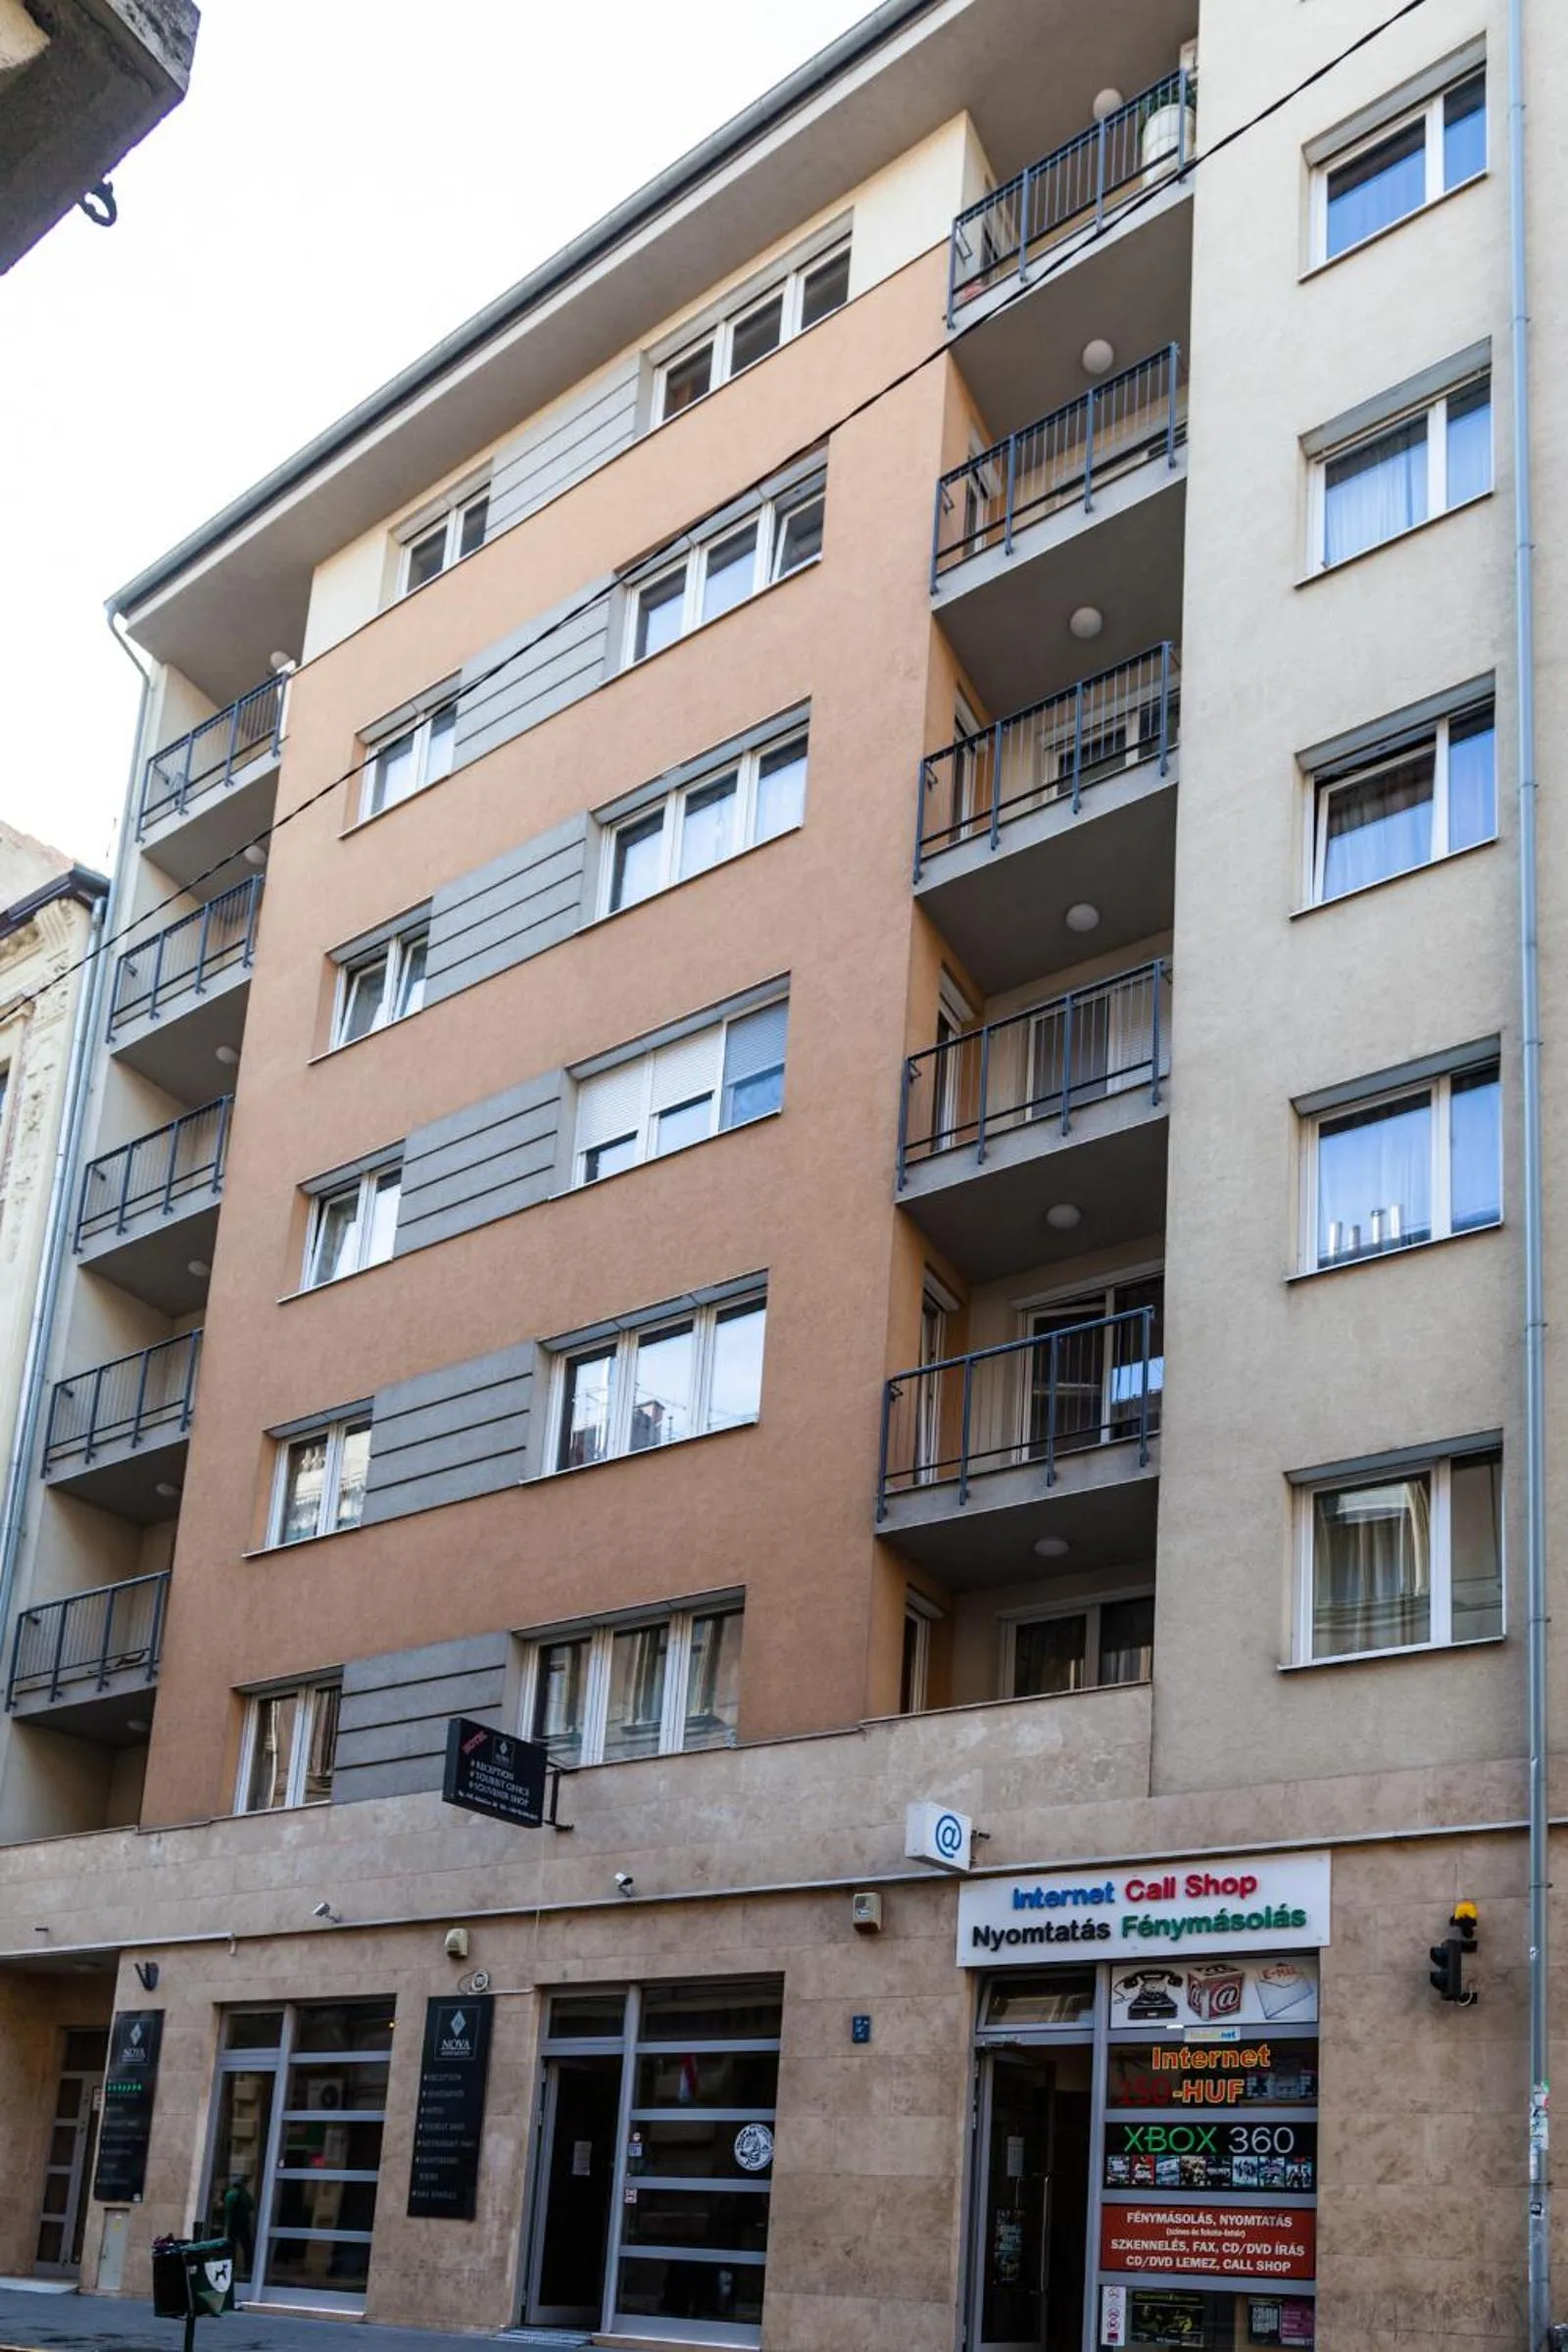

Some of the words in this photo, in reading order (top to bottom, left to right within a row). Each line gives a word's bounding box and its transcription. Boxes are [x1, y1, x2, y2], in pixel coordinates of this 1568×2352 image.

[1012, 1882, 1115, 1909] Internet
[1125, 1876, 1176, 1903] Call
[1185, 1874, 1257, 1901] Shop
[972, 1918, 1111, 1952] Nyomtatás
[1121, 1903, 1307, 1941] Fénymásolás
[440, 2038, 471, 2050] NOVA
[1152, 2043, 1271, 2070] Internet
[1124, 2126, 1217, 2152] XBOX
[1229, 2127, 1294, 2154] 360
[1126, 2211, 1217, 2226] FÉNYMÁSOLÁS,
[1219, 2214, 1293, 2228] NYOMTATÁS
[1111, 2238, 1190, 2253] SZKENNELÉS,
[1192, 2241, 1218, 2254] FAX,
[1222, 2242, 1271, 2255] CD/DVD
[1275, 2242, 1305, 2257] ÍRÁS
[1126, 2255, 1174, 2268] CD/DVD
[1176, 2256, 1220, 2271] LEMEZ,
[1223, 2258, 1253, 2271] CALL
[1256, 2261, 1292, 2273] SHOP
